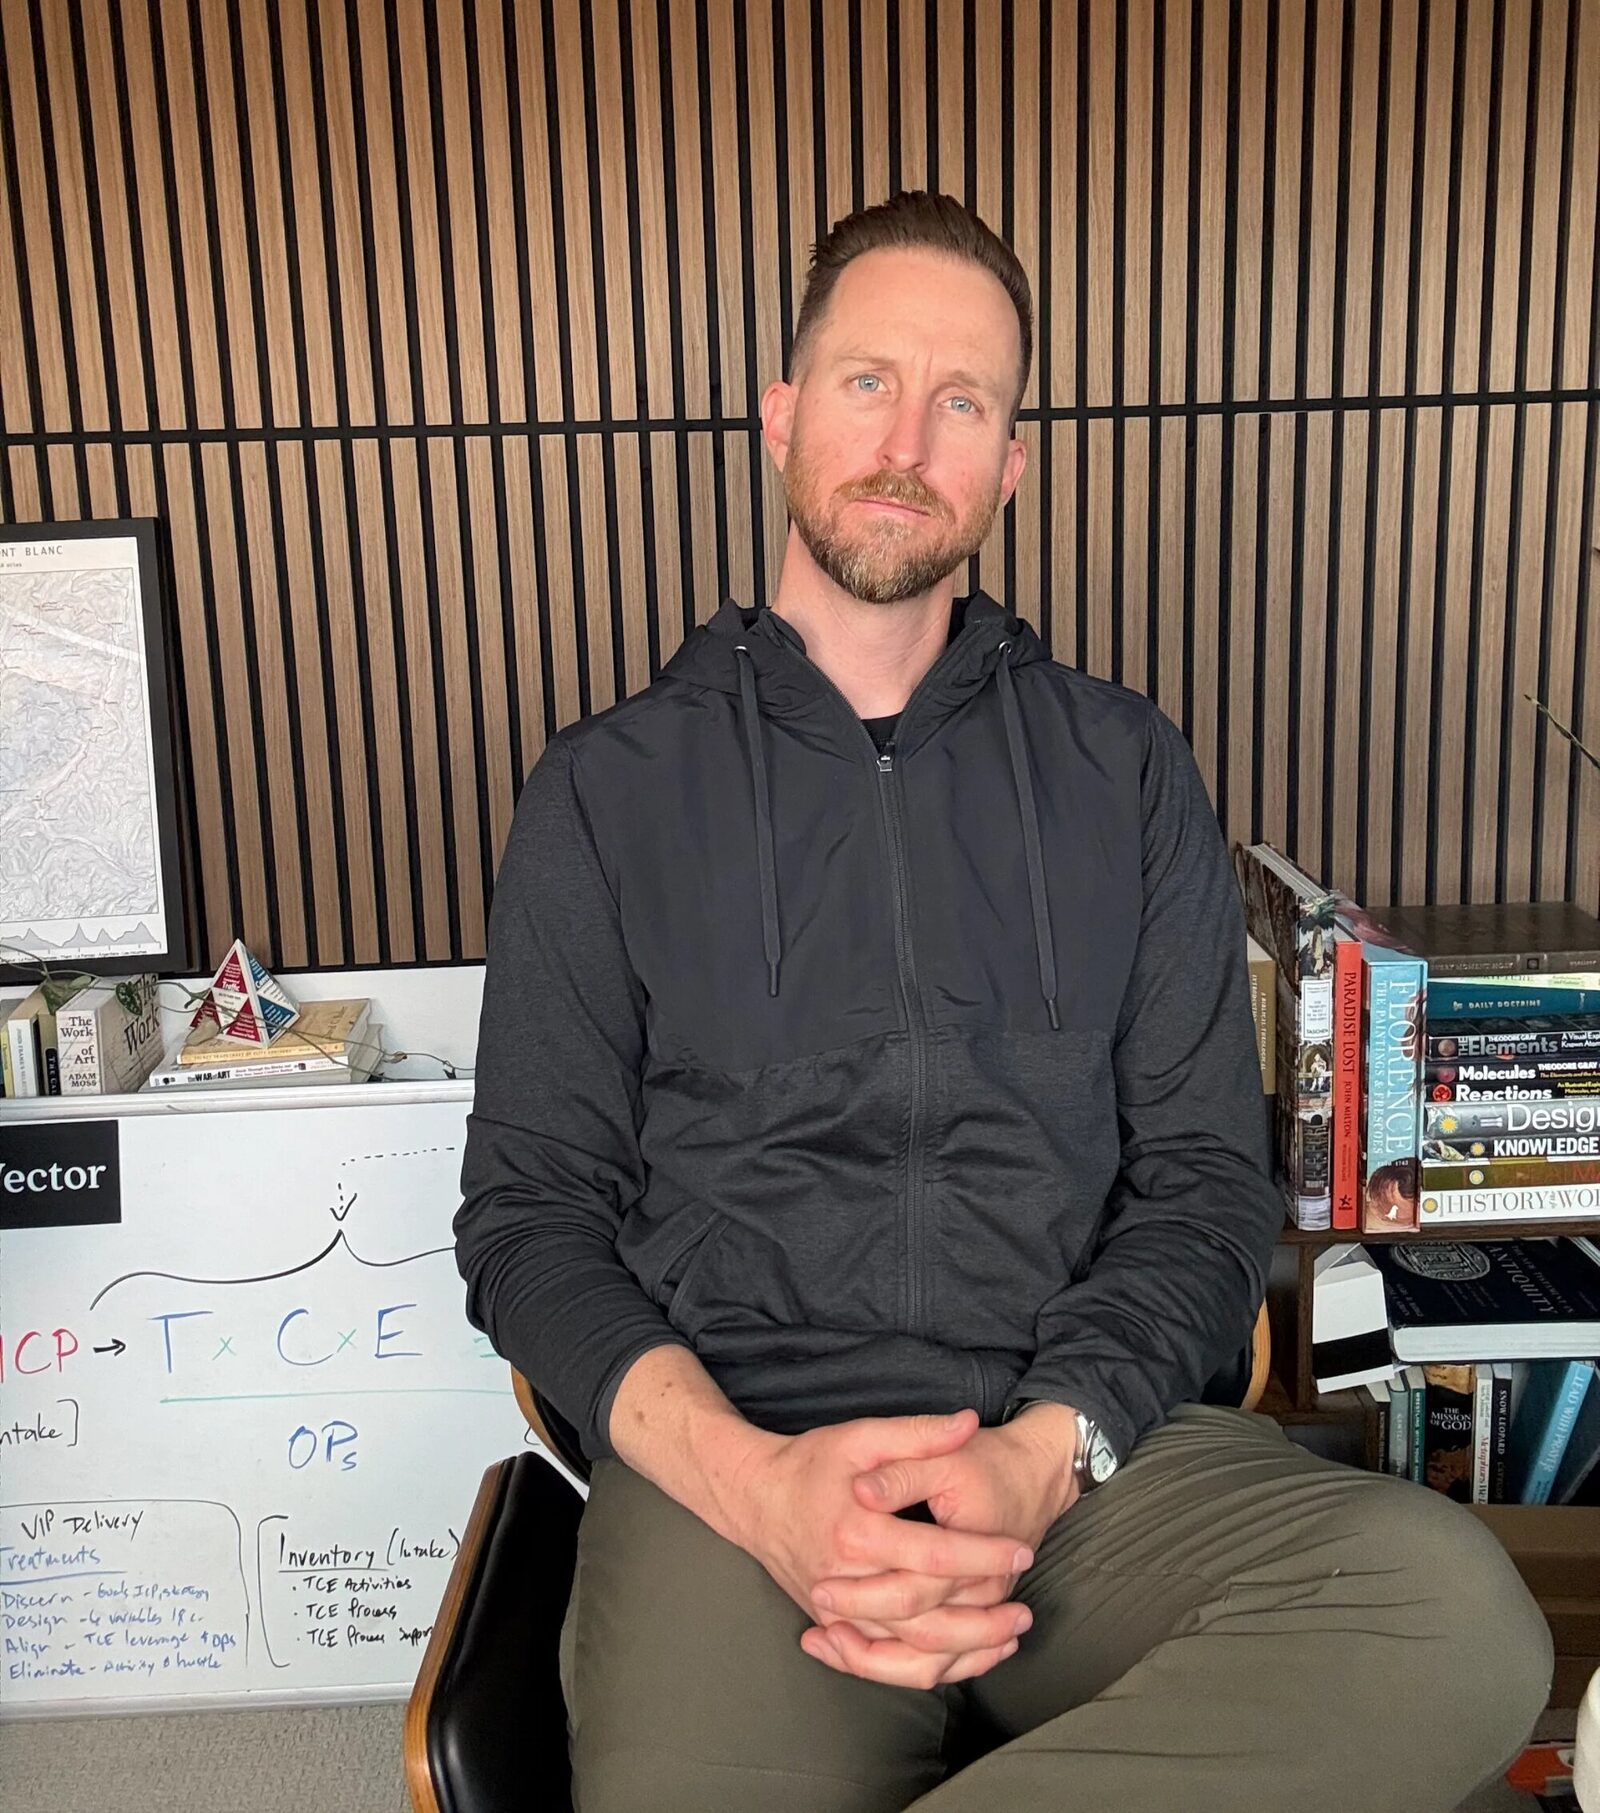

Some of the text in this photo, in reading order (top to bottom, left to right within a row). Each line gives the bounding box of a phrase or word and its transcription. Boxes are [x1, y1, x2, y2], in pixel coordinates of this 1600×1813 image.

[0, 545, 63, 557] NT BLANC
[1376, 980, 1387, 1006] THE
[1468, 999, 1541, 1009] DAILY DOCTRINE
[60, 1026, 94, 1038] Work
[69, 1016, 92, 1027] The
[124, 1005, 160, 1056] Work
[1342, 971, 1357, 1075] PARADISE LOST
[1374, 1009, 1387, 1077] PAINTINGS
[1458, 1035, 1559, 1056] THE Elements
[1521, 1033, 1538, 1041] GRAY
[1561, 1032, 1568, 1040] A
[1568, 1031, 1587, 1040] Visual
[1561, 1040, 1583, 1048] Known
[74, 1055, 96, 1065] Art
[81, 1044, 95, 1056] of
[48, 1056, 56, 1076] THE
[195, 1072, 213, 1082] WAR
[217, 1070, 231, 1079] ART
[1386, 980, 1418, 1154] FLORENCE
[1458, 1061, 1598, 1081] Molecules THEODORE GRAY
[68, 1073, 97, 1081] ADAM
[71, 1080, 97, 1088] MOSS
[1374, 1080, 1386, 1089] &
[1343, 1081, 1353, 1104] JOHN
[1455, 1084, 1553, 1102] Reactions
[1343, 1105, 1353, 1138] MILTON
[1372, 1091, 1385, 1154] FRESCOES
[1493, 1136, 1600, 1157] KNOWLEDGE
[1448, 1190, 1548, 1214] HISTORY
[1486, 1245, 1559, 1315] ANTIQUITY
[148, 1310, 213, 1373] T
[277, 1308, 334, 1366] C
[375, 1304, 423, 1359] E
[1567, 1375, 1585, 1405] LEAD
[1498, 1389, 1508, 1416] SNOW
[1431, 1410, 1472, 1421] MISSION
[1441, 1420, 1472, 1431] GOD
[1558, 1406, 1575, 1433] WITH
[1497, 1416, 1507, 1456] LEOPARD
[1478, 1436, 1489, 1483] Metaphors
[1539, 1433, 1566, 1473] PRAYER
[1478, 1484, 1487, 1497] We
[21, 1509, 144, 1542] VIP Delivery
[279, 1532, 375, 1569] Inventory
[303, 1575, 413, 1593] TCE Activities
[306, 1603, 339, 1620] TCE
[1, 1613, 68, 1636] Design
[306, 1628, 339, 1648] TCE
[5, 1638, 50, 1660] Align
[9, 1659, 87, 1680] Eliminate
